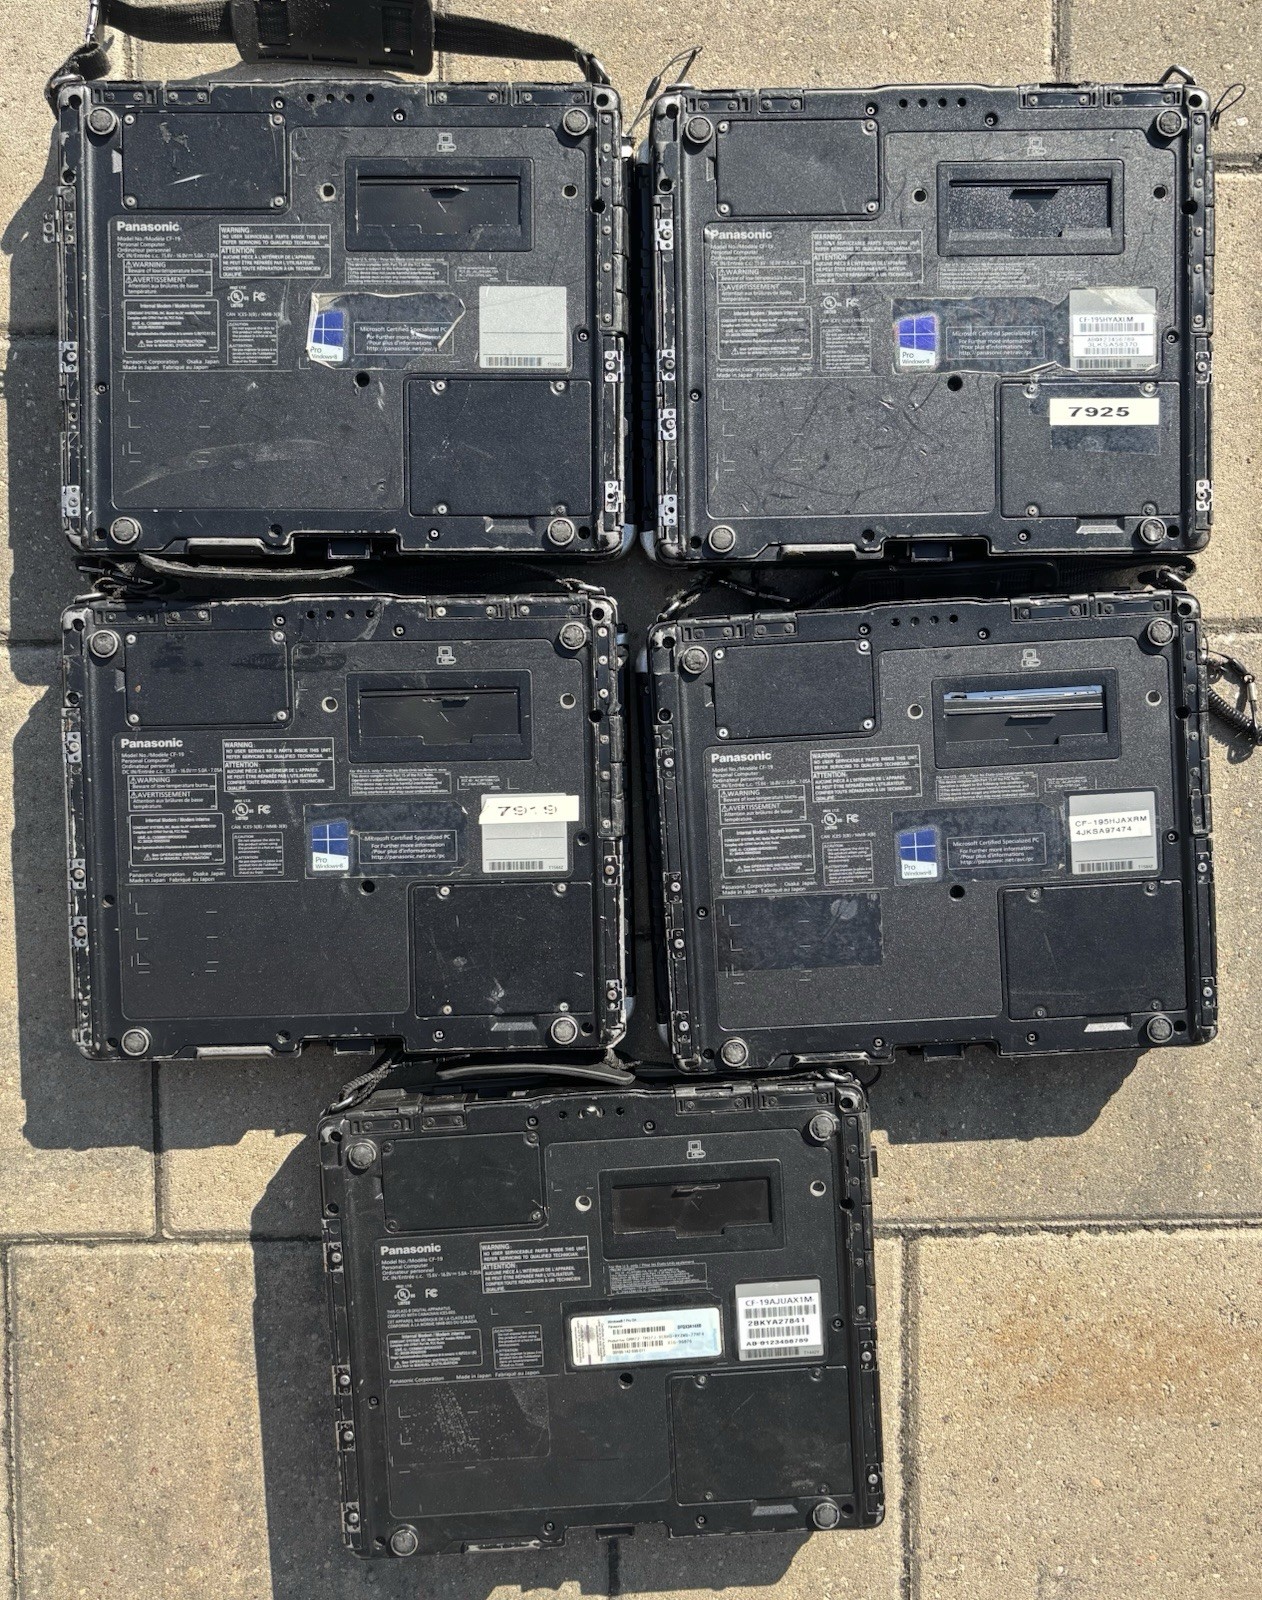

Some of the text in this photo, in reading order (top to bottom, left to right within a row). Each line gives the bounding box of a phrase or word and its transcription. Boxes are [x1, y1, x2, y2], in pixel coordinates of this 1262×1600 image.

[117, 221, 180, 232] Panasonic
[710, 230, 773, 240] Panasonic
[1068, 406, 1130, 417] 7925
[121, 738, 183, 748] Panasonic
[711, 751, 772, 763] Panasonic
[498, 804, 558, 817] 799
[729, 803, 780, 811] AVERTISSEMENT
[1076, 826, 1132, 836] 4JKSA97474
[380, 1243, 442, 1256] Panasonic
[410, 1267, 435, 1275] personnel
[746, 1296, 813, 1306] CF-19AJUAX1M
